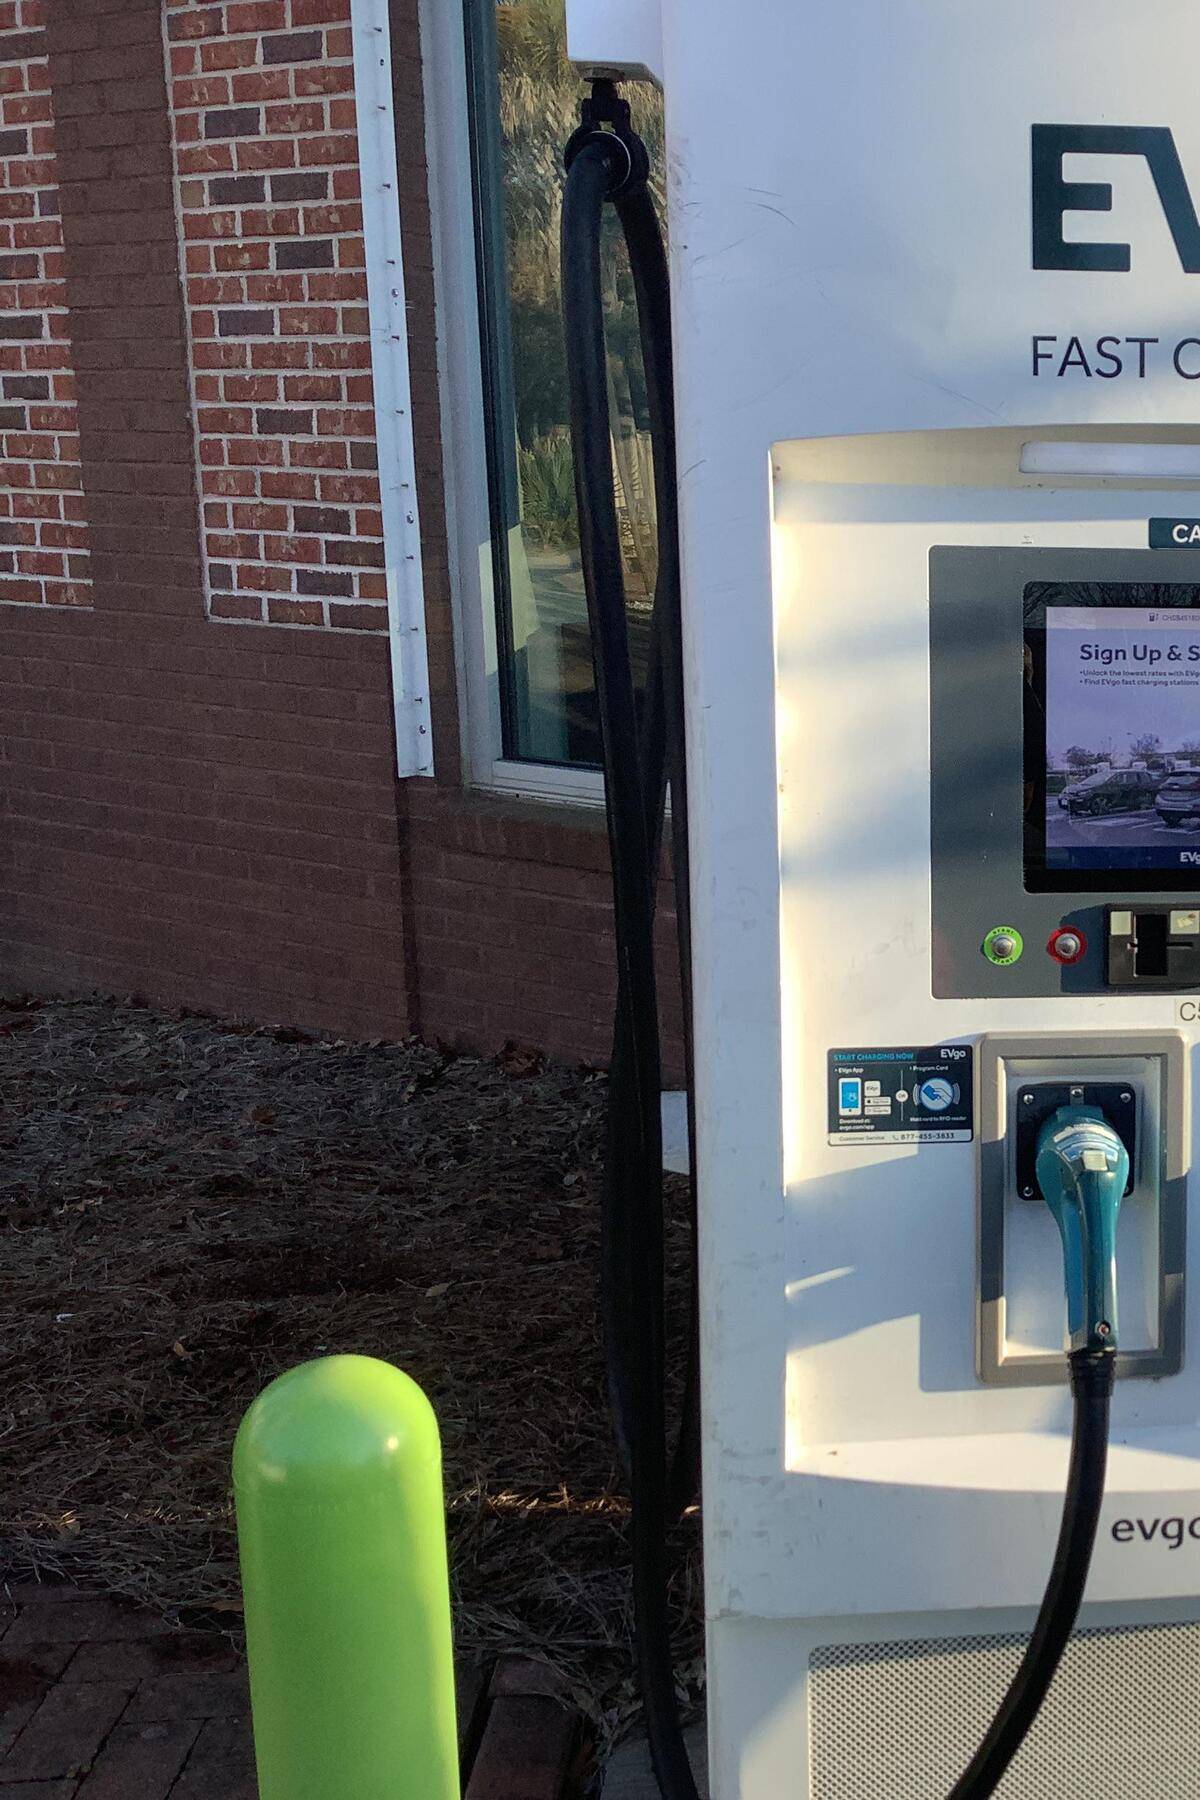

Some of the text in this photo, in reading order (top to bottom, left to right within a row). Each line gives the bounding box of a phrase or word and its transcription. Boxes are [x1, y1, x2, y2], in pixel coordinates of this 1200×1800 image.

[1032, 335, 1159, 378] FAST
[1080, 644, 1126, 665] Sign
[1133, 645, 1162, 665] Up
[1167, 645, 1182, 661] &
[1137, 679, 1168, 687] charging
[833, 1052, 914, 1061] START CHARGING NOW
[940, 1048, 966, 1060] EVgo
